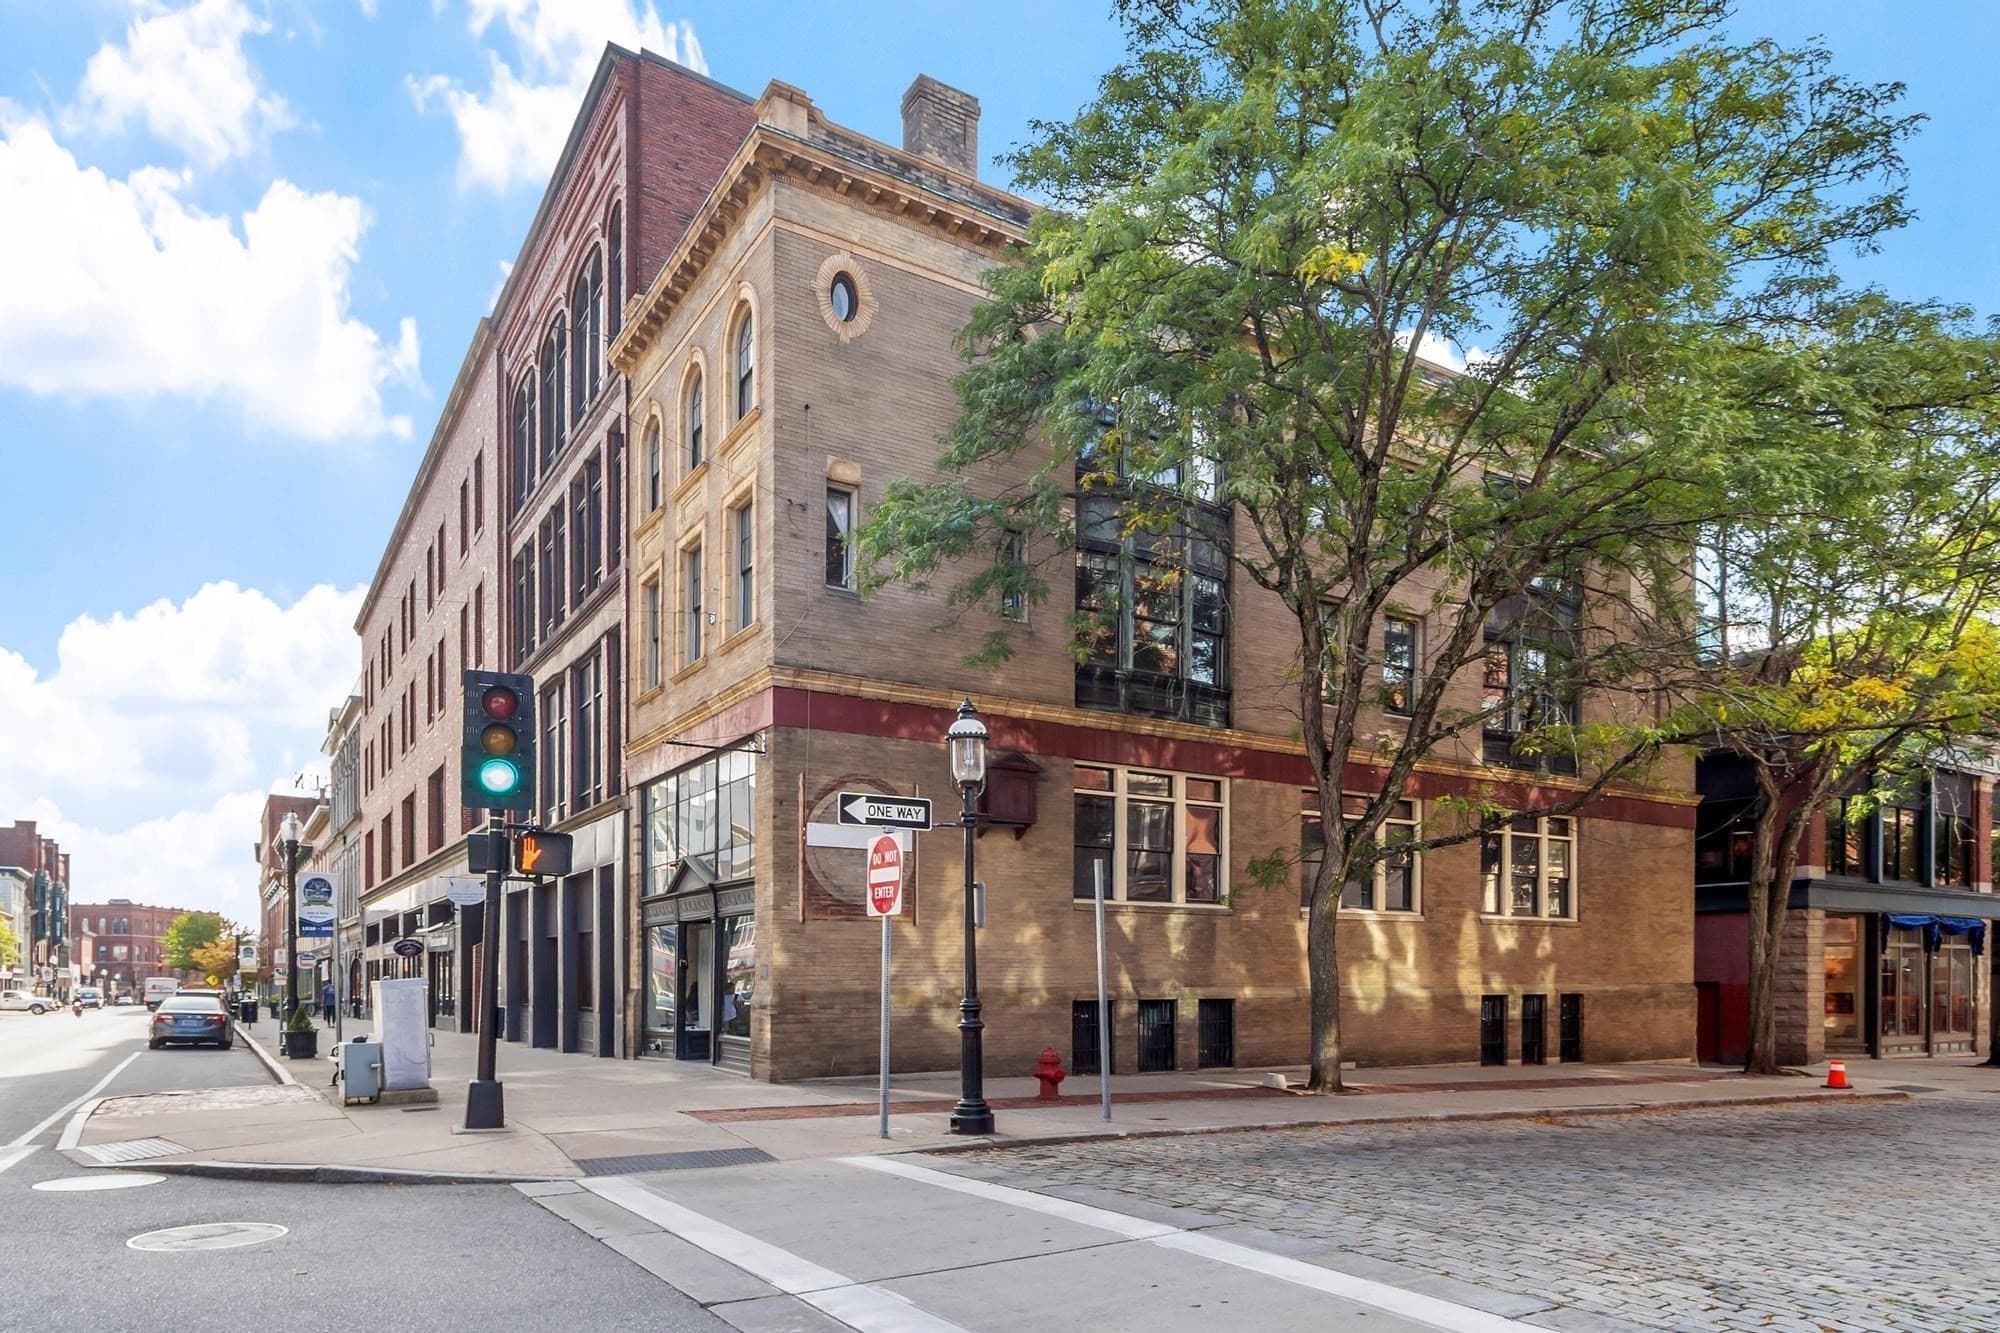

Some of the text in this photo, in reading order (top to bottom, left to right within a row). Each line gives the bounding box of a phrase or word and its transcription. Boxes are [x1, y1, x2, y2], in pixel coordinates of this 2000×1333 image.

[868, 804, 921, 820] ONE WAY
[872, 849, 897, 866] DO NOT
[874, 885, 894, 900] ENTER
